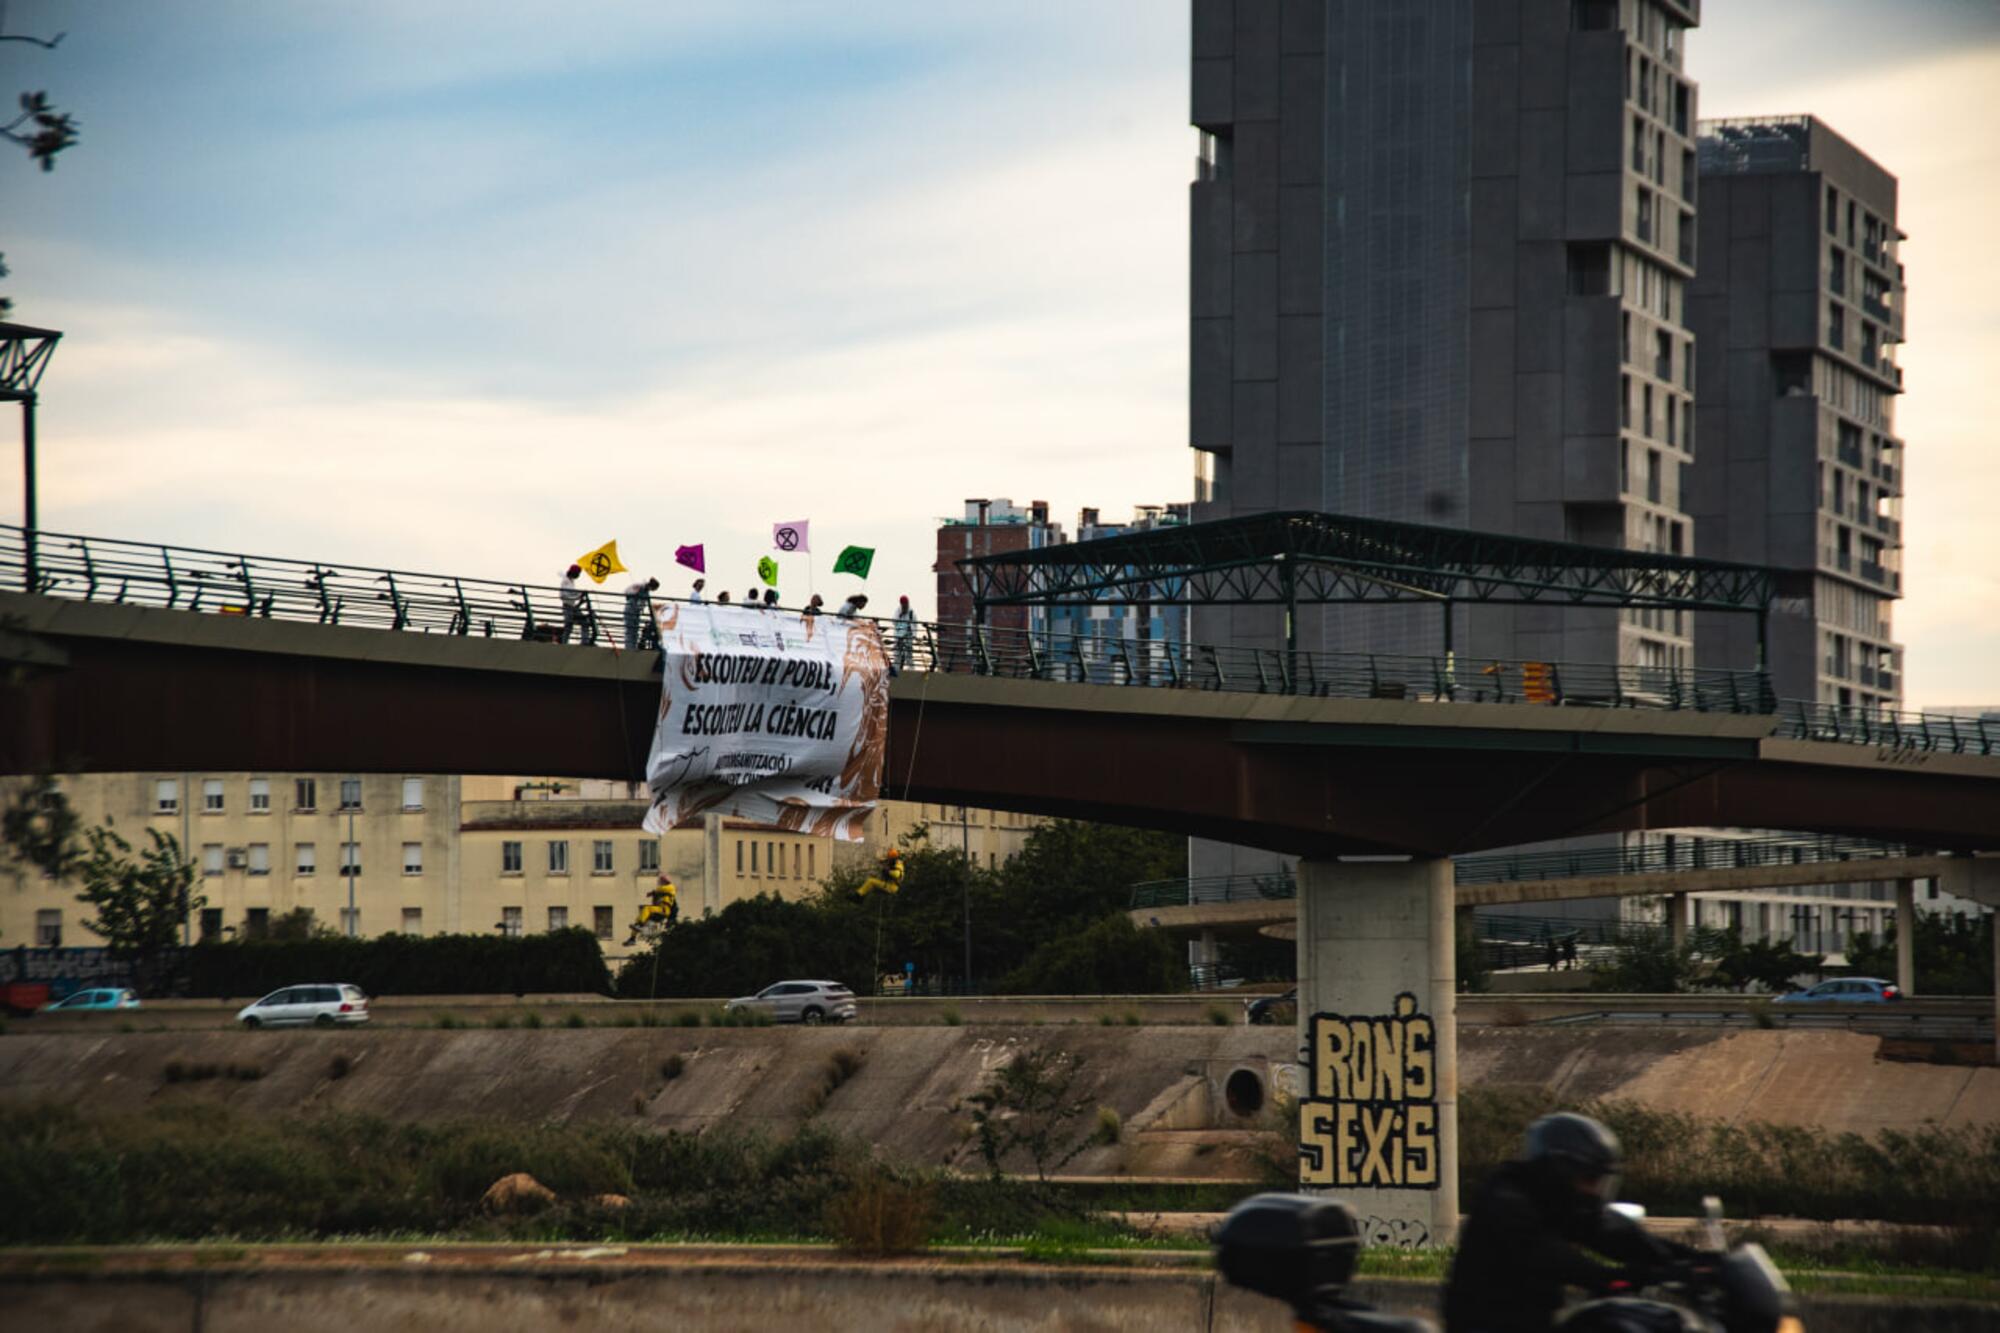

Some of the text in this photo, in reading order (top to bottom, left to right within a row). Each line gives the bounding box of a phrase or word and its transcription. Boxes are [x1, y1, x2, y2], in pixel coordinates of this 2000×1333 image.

[695, 654, 837, 696] ESCOLTEU EL POBLE,
[682, 699, 838, 741] ESCOLTEU LA CIÈNCIA
